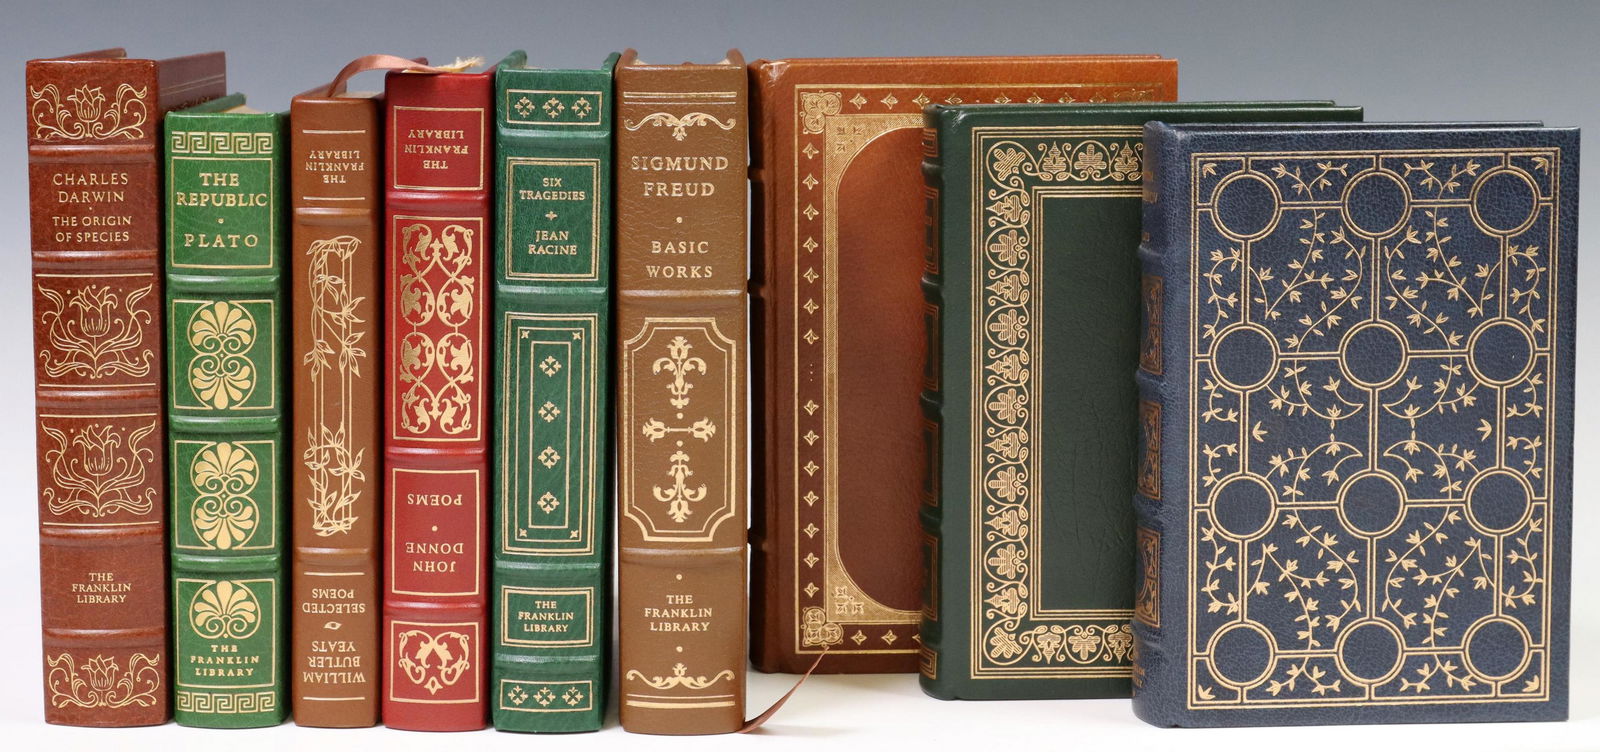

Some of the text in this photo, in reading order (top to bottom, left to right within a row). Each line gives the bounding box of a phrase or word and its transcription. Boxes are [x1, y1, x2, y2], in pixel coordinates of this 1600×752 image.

[408, 129, 464, 139] LIBRARY
[309, 150, 360, 160] LIBRARY
[404, 144, 469, 155] FRANKLIN
[305, 162, 364, 172] FRANKLIN
[424, 160, 448, 170] THE
[631, 156, 729, 171] SIGMUND
[53, 172, 129, 186] CHARLES
[199, 173, 239, 187] THE
[323, 174, 346, 183] THE
[543, 178, 562, 188] SIX
[643, 182, 715, 197] FREUD
[58, 191, 124, 203] DARWIN
[176, 192, 267, 207] REPUBLIC
[520, 190, 585, 201] TRAGEDIES
[52, 216, 131, 227] THE ORIGIN
[56, 231, 129, 242] OF SPECIES
[185, 234, 258, 248] PLATO
[535, 230, 569, 242] JEAN
[528, 244, 577, 256] RACINE
[652, 241, 709, 254] BASIC
[647, 265, 713, 279] WORKS
[408, 494, 462, 506] POEMS
[406, 542, 463, 554] DONNE
[412, 560, 456, 573] JOHN
[89, 572, 113, 582] THE
[72, 583, 131, 592] FRANKLIN
[77, 594, 127, 603] LIBRARY
[312, 588, 354, 599] POEMS
[666, 594, 693, 604] THE
[302, 602, 366, 613] SELECTED
[535, 600, 557, 609] THE
[518, 612, 574, 621] FRANKLIN
[645, 607, 712, 618] FRANKLIN
[524, 623, 569, 633] LIBRARY
[650, 621, 710, 632] LIBRARY
[211, 644, 238, 653] THE
[312, 641, 356, 652] YEATS
[191, 655, 259, 664] FRANKLIN
[308, 656, 361, 667] BUTLER
[195, 668, 253, 677] LIBRARY
[303, 671, 366, 684] WILLIAM
